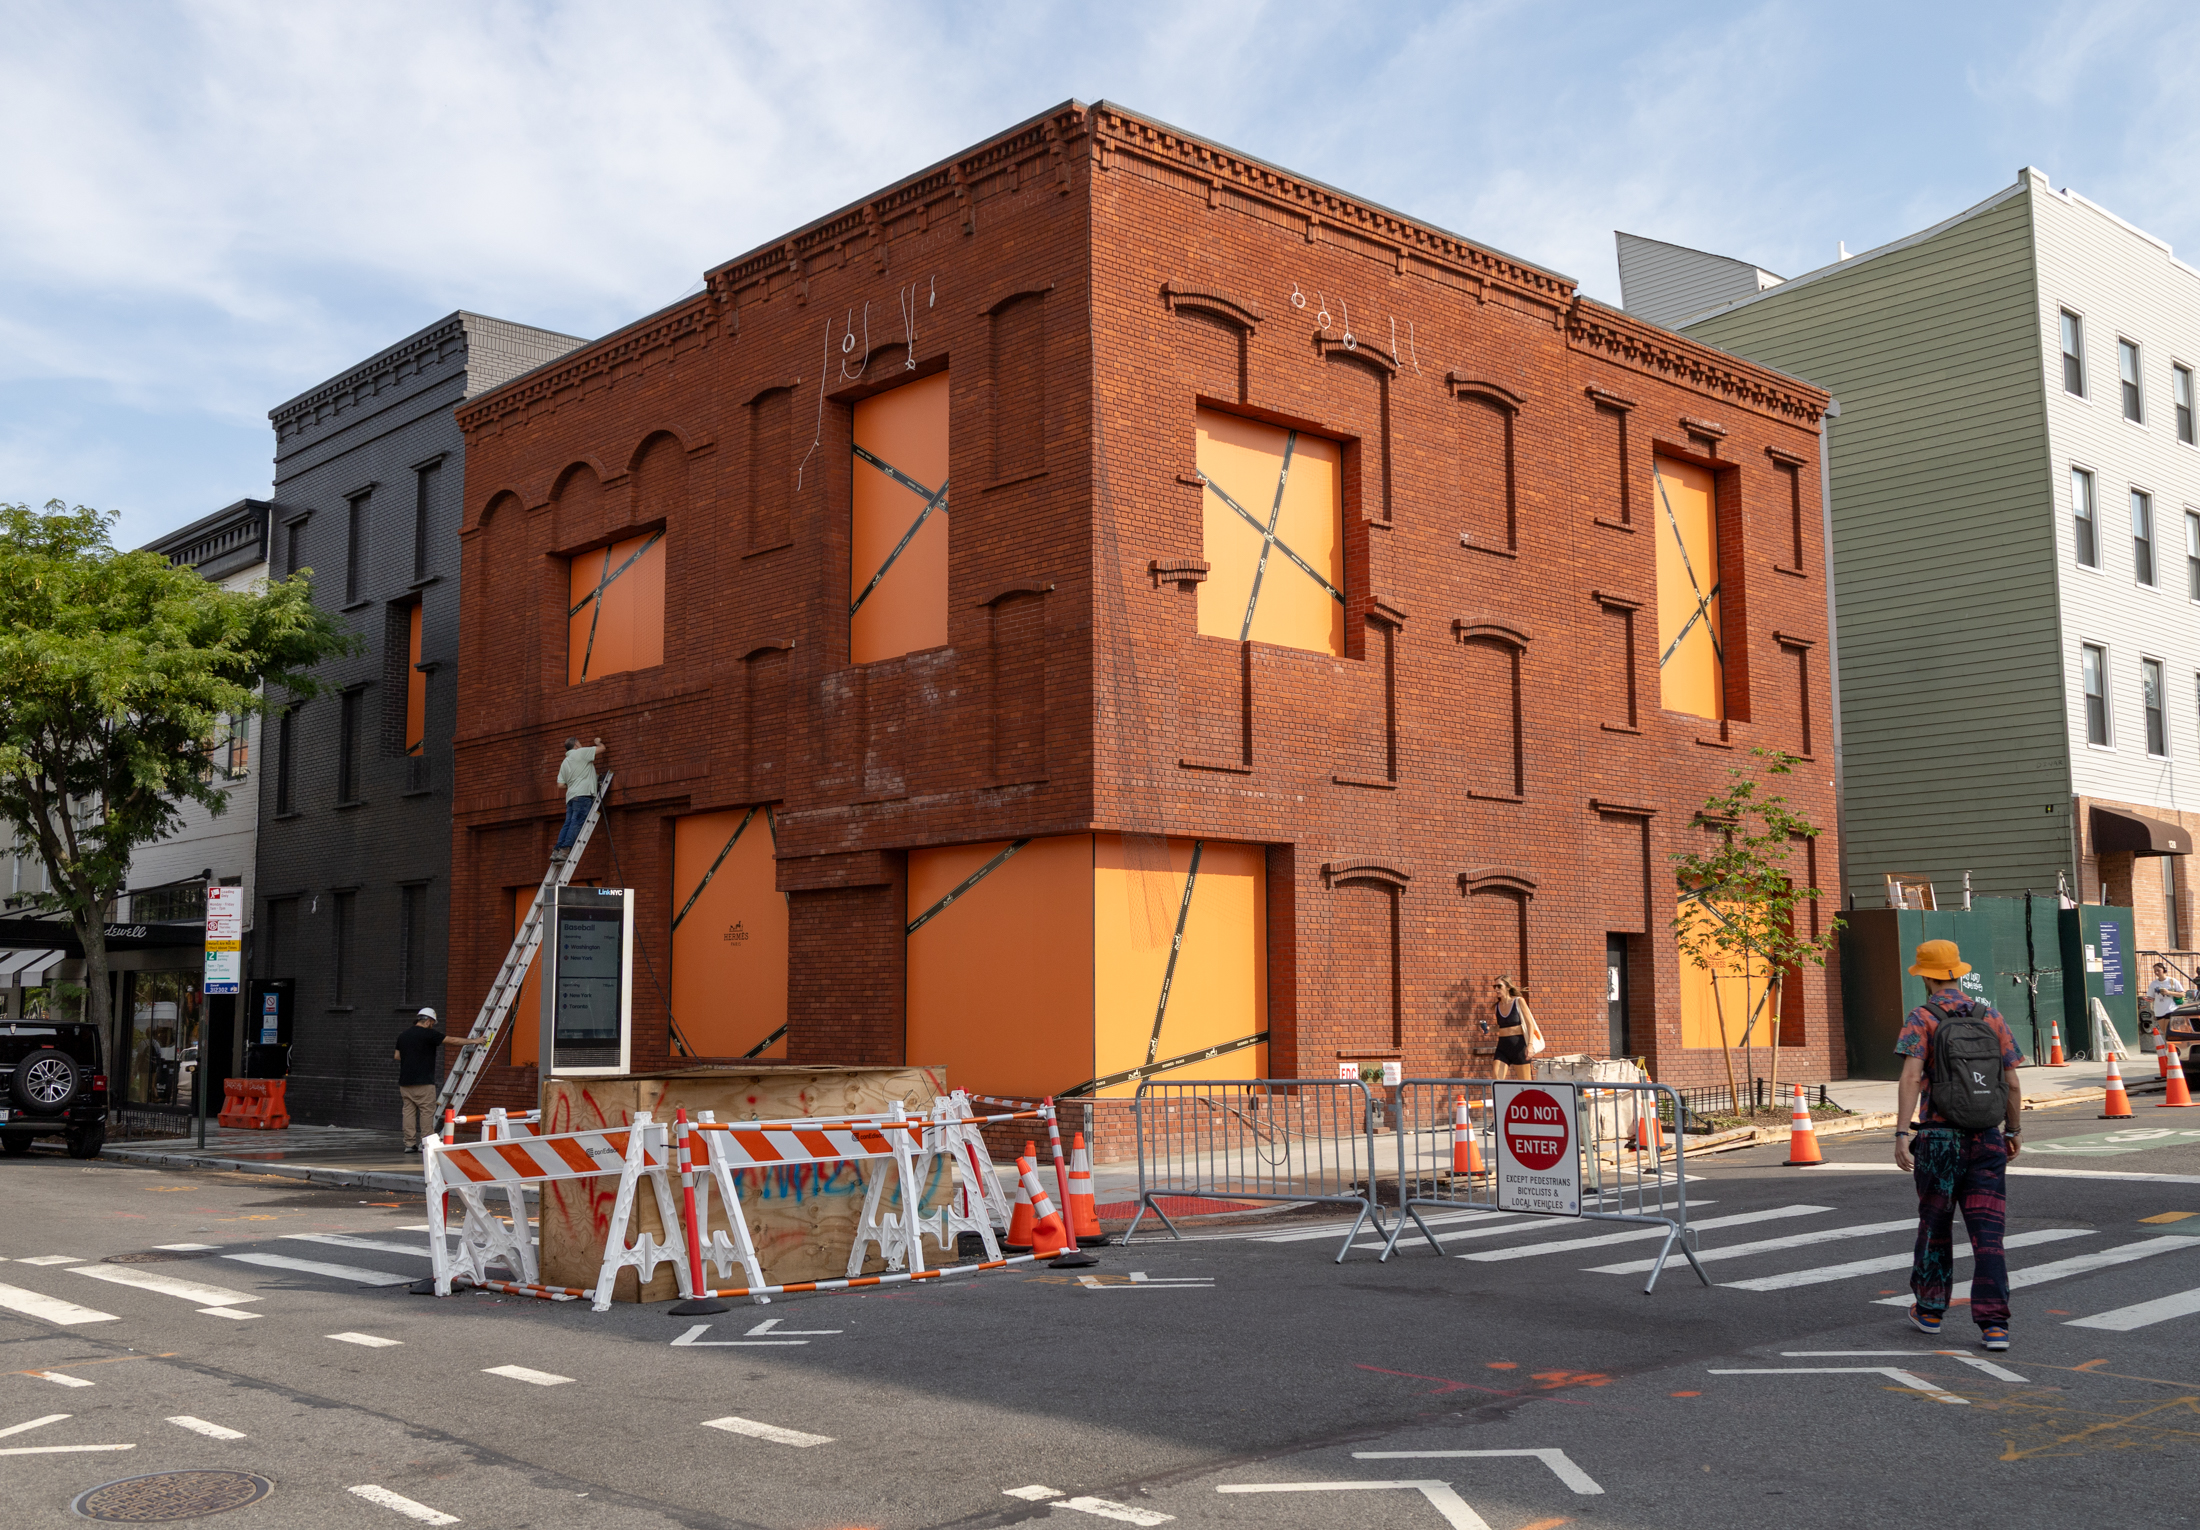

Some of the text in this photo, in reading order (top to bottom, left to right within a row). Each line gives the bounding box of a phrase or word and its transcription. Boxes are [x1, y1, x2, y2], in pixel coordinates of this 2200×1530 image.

[104, 924, 147, 938] dewell
[209, 952, 214, 960] 2
[1511, 1106, 1559, 1120] DO NOT
[1516, 1140, 1558, 1155] ENTER
[1506, 1175, 1570, 1187] EXCEPT PEDESTRIANS
[1518, 1187, 1559, 1197] BICYCLISTS &
[1512, 1198, 1531, 1207] LOCAL
[1534, 1199, 1563, 1210] VEHICLES
